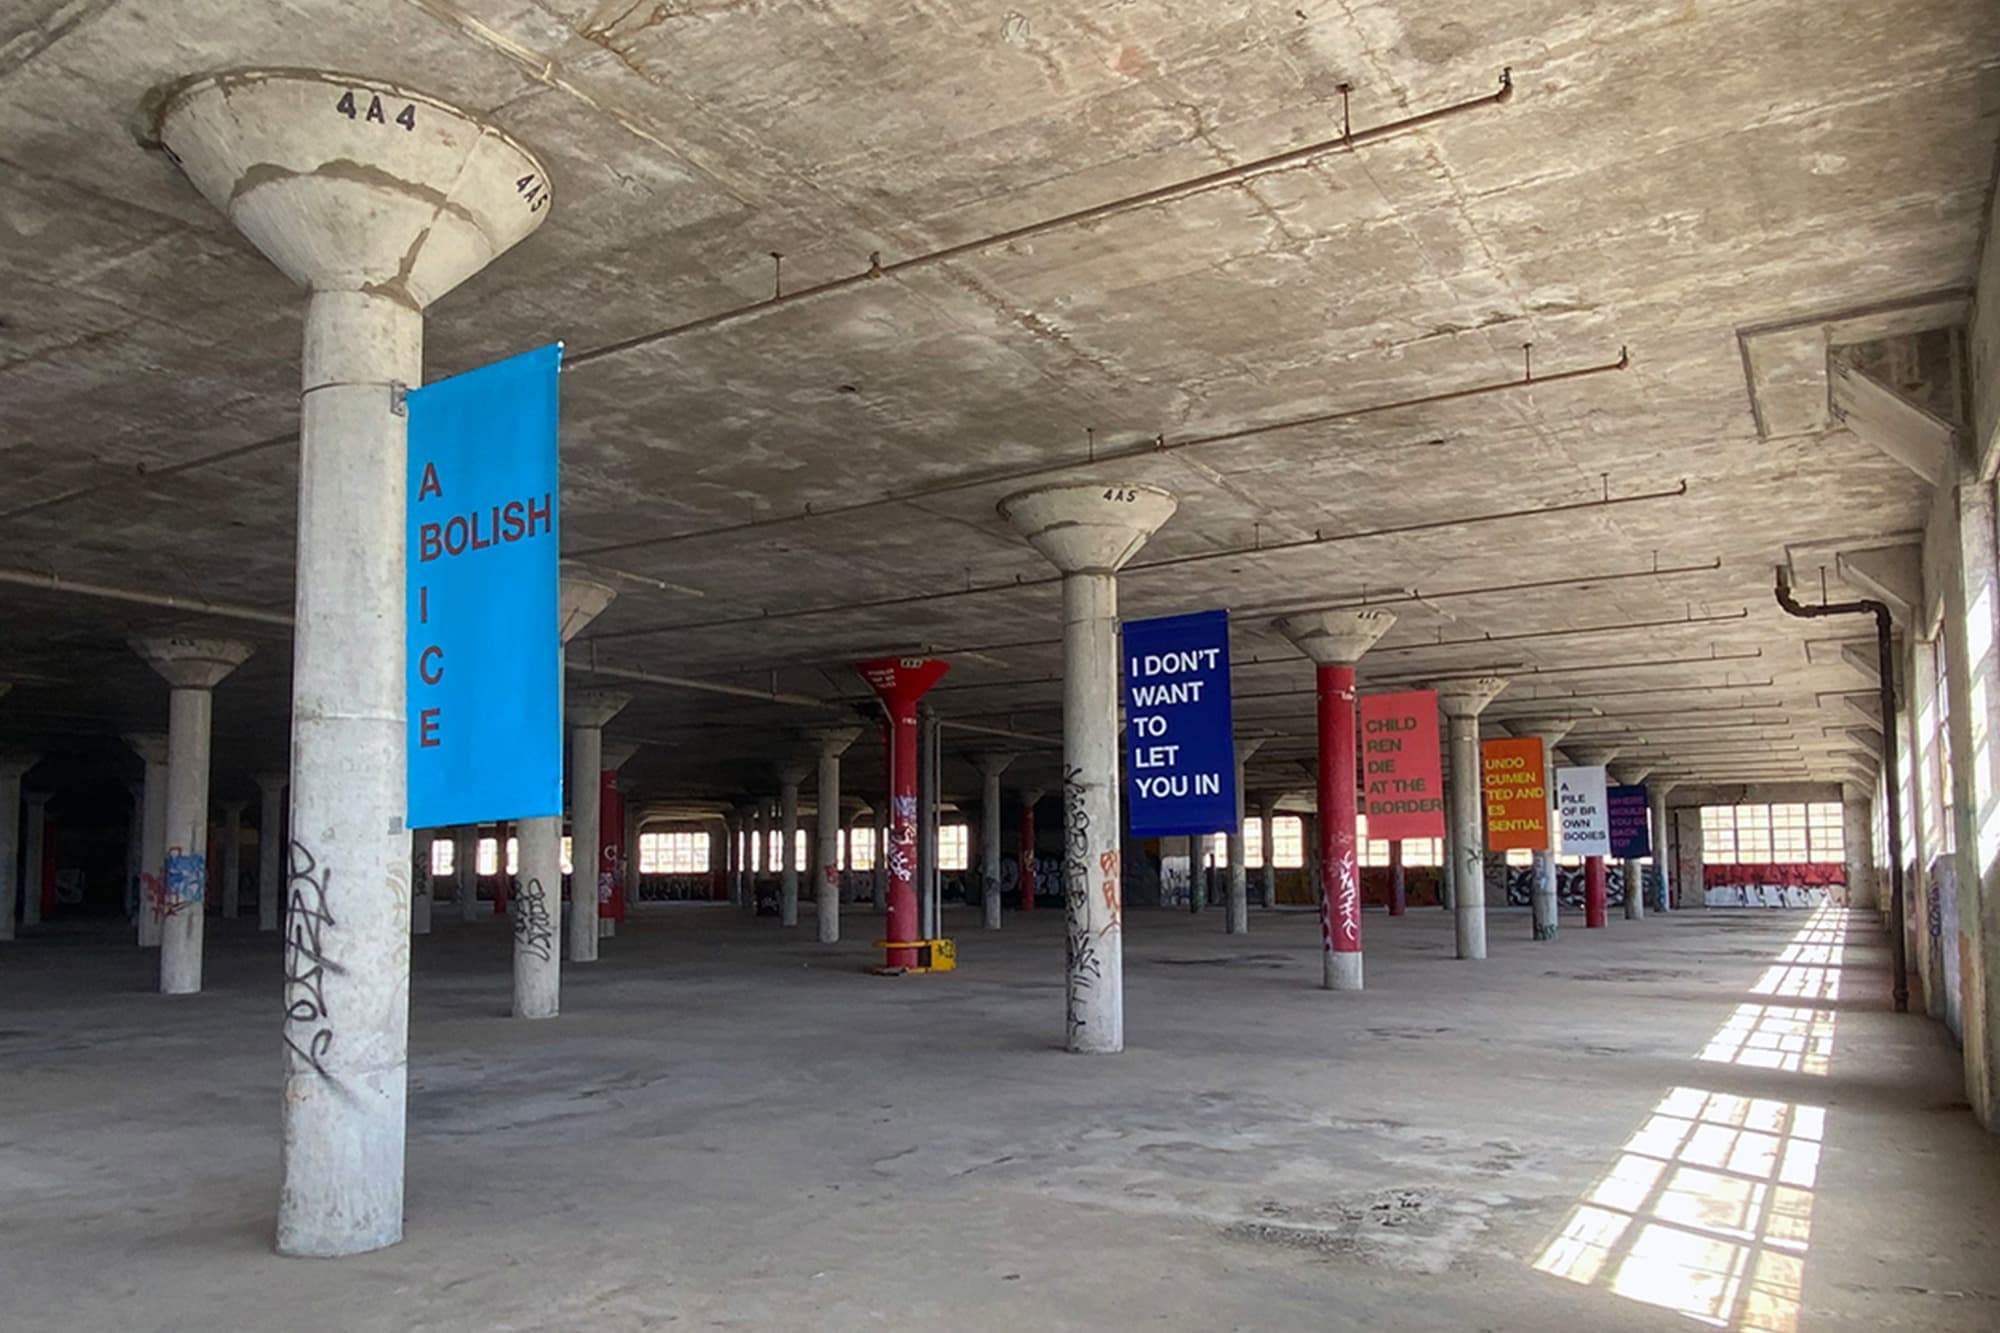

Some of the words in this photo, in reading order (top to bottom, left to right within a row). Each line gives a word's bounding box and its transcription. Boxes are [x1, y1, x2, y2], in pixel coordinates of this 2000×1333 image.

[336, 91, 417, 131] 4A4
[418, 462, 443, 501] A
[419, 493, 551, 562] BOLISH
[1132, 657, 1138, 677] I
[1144, 648, 1220, 676] DON'T
[1132, 681, 1204, 707] WANT
[1133, 715, 1167, 738] TO
[1365, 717, 1417, 733] CHILD
[1367, 739, 1402, 752] REN
[1135, 745, 1179, 768] LET
[1486, 756, 1525, 769] UNDO
[1368, 760, 1394, 774] DIE
[1486, 772, 1535, 785] CUMEN
[1135, 775, 1188, 799] YOU
[1195, 773, 1219, 795] IN
[1369, 781, 1387, 794] AT
[1392, 778, 1425, 792] THE
[1561, 782, 1569, 791] A
[1488, 789, 1513, 800] TED
[1516, 787, 1544, 799] AND
[1562, 795, 1585, 804] PILE
[1370, 799, 1443, 815] BORDER
[1488, 805, 1505, 816] ES
[1562, 807, 1577, 816] OF
[1580, 806, 1597, 816] BR
[1489, 819, 1544, 831] SENTIAL
[1563, 819, 1590, 829] OWN
[1564, 831, 1606, 841] BODIES
